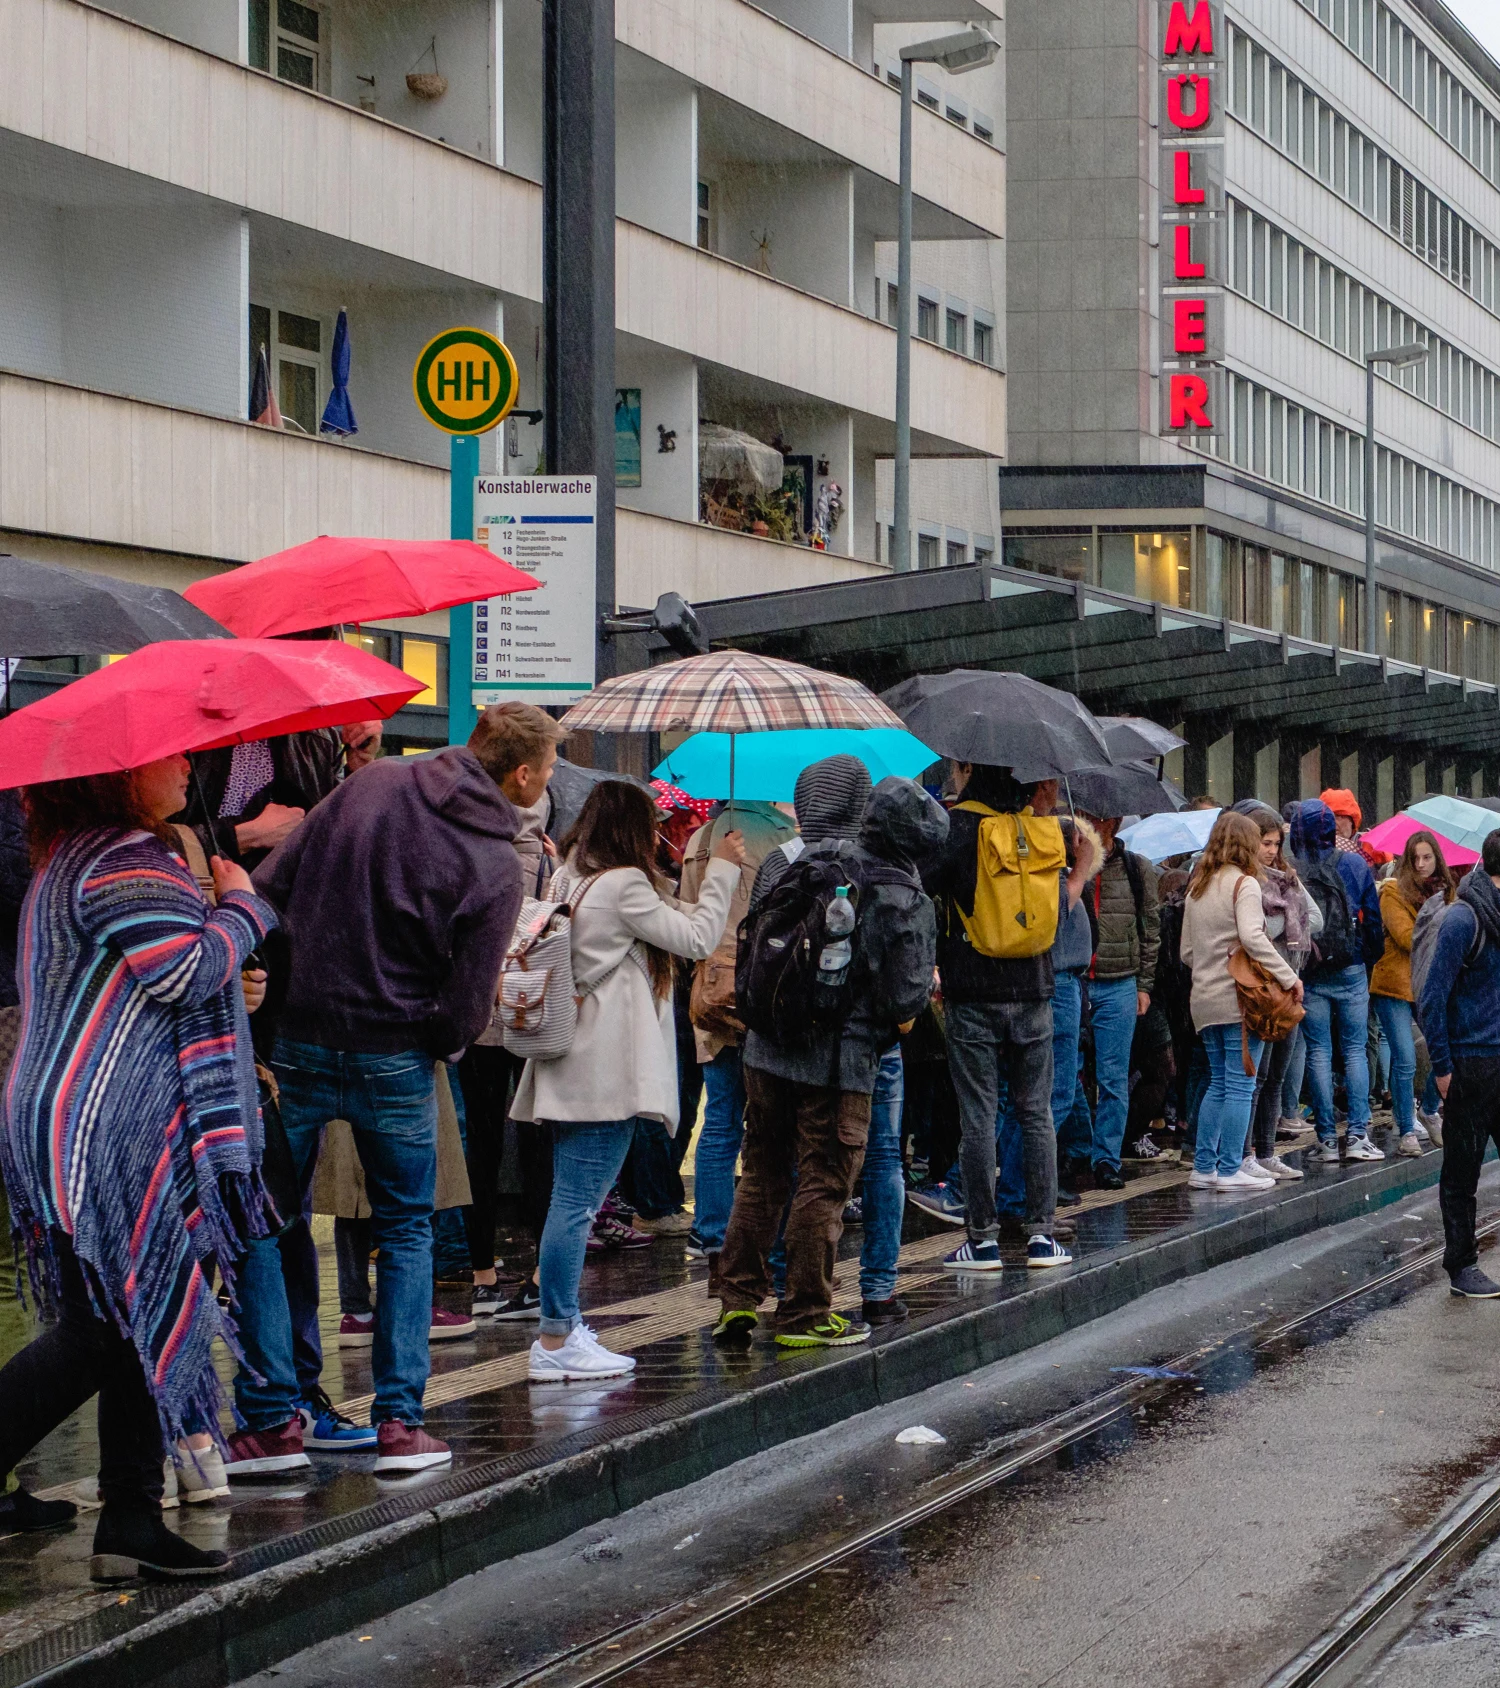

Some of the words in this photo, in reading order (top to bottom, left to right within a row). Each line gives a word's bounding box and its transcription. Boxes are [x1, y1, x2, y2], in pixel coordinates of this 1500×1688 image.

[1164, 1, 1213, 429] MÜLLER
[438, 361, 490, 401] HH
[478, 480, 592, 494] Konstablerwache
[503, 531, 513, 540] 12
[502, 547, 513, 556] 18
